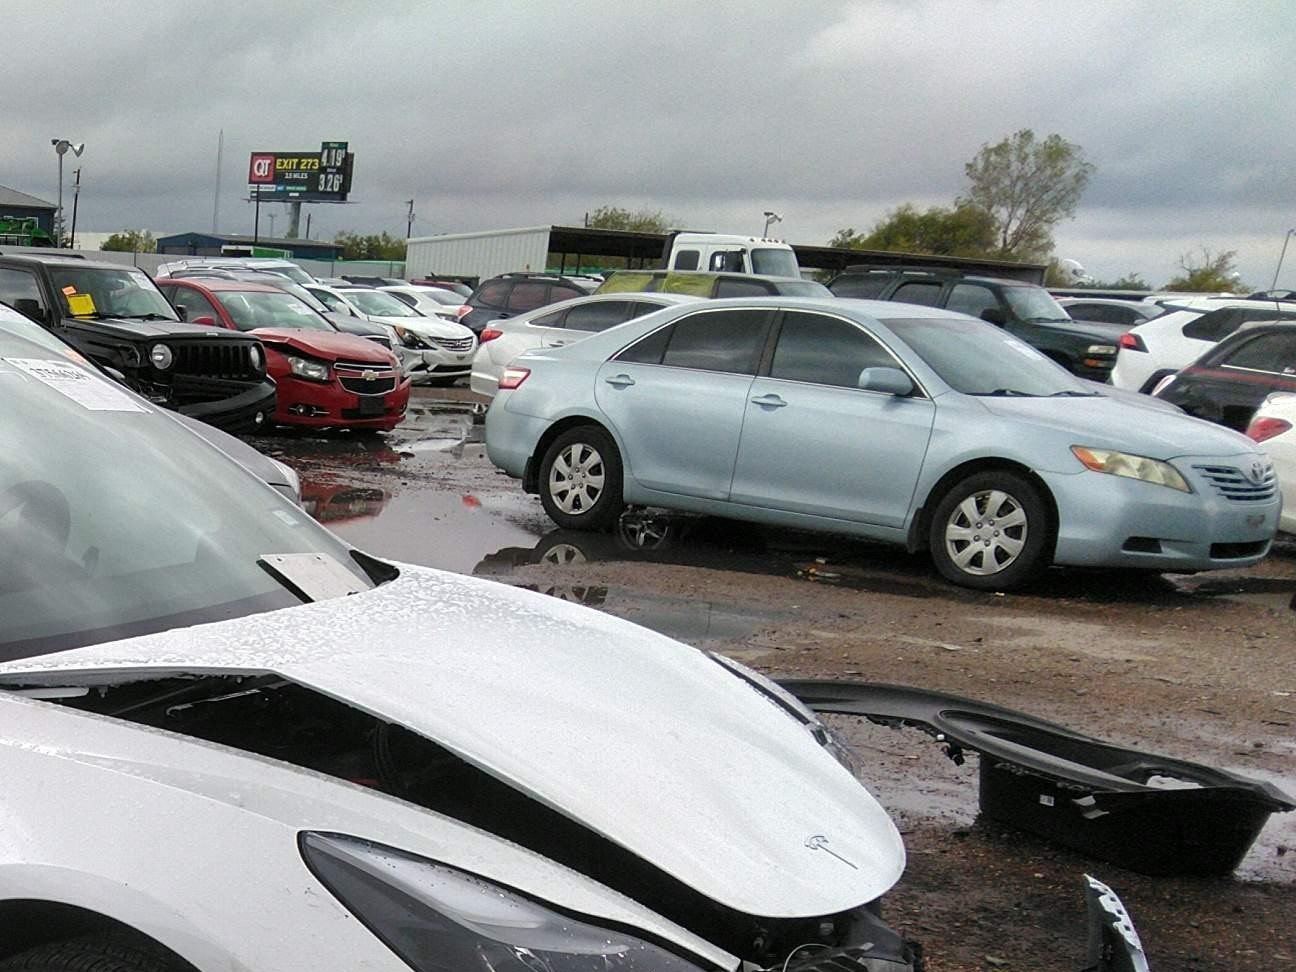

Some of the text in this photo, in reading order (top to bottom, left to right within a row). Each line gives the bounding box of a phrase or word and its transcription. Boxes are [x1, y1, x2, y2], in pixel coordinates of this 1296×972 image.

[253, 159, 272, 177] QT
[275, 158, 320, 170] EXIT 273
